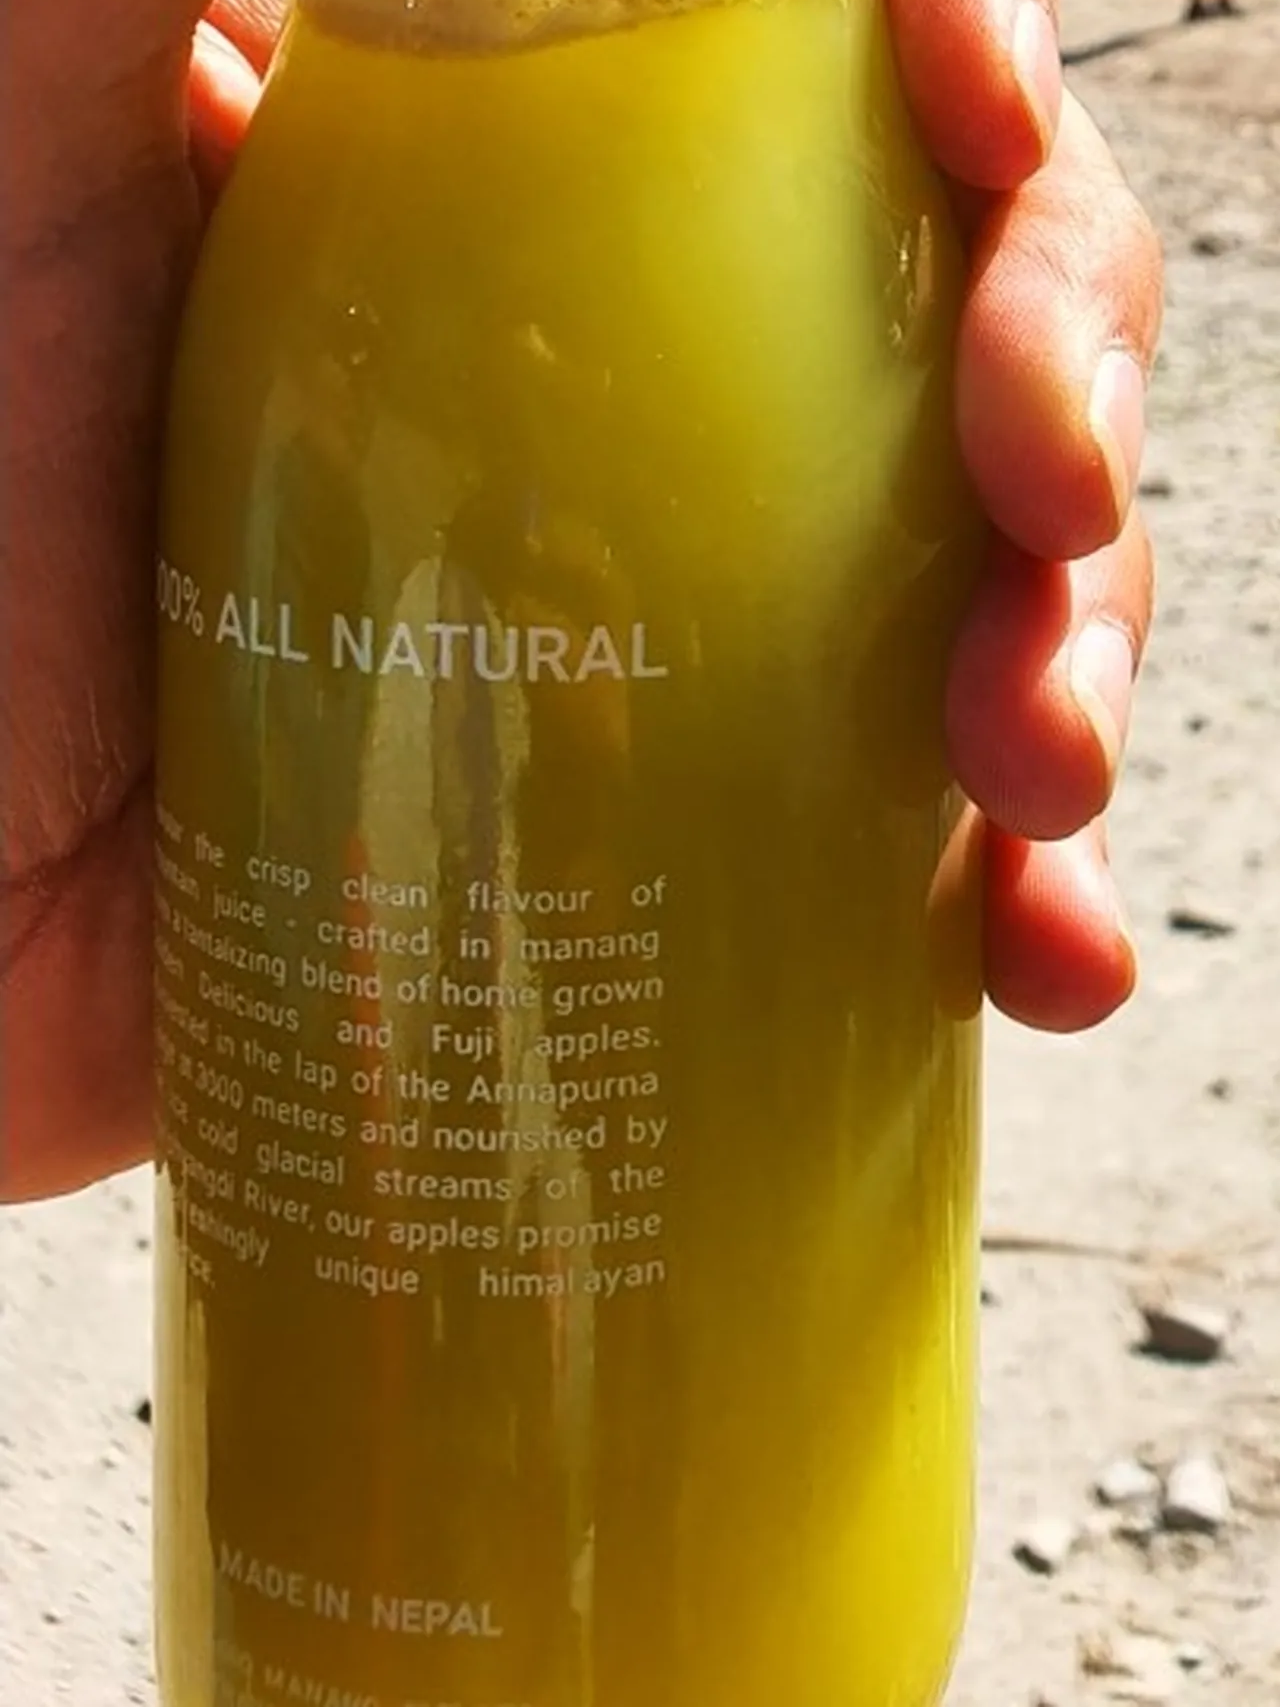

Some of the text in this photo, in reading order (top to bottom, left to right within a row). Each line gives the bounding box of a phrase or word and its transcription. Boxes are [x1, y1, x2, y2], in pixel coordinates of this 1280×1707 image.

[157, 556, 669, 682] 00% ALL NATURAL
[214, 884, 266, 929] juice
[318, 921, 430, 956] crafted
[459, 928, 491, 960] in
[520, 930, 659, 961] manang
[246, 856, 311, 897] crisp
[342, 873, 428, 909] clean
[467, 881, 593, 914] flavour
[631, 874, 667, 908] of
[199, 970, 300, 1032] Delicious
[337, 1018, 393, 1048] and
[432, 1024, 494, 1063] Fuji
[534, 1023, 661, 1063] apples.
[302, 956, 381, 1000] blend
[397, 972, 431, 1003] of
[441, 975, 540, 1007] home
[552, 977, 664, 1016] grown
[244, 1038, 281, 1074] the
[295, 1049, 337, 1094] lap
[351, 1065, 384, 1097] of
[398, 1069, 451, 1102] the
[466, 1071, 659, 1111] Annapurna
[198, 1118, 238, 1156] cold
[256, 1140, 345, 1186] glacial
[374, 1169, 512, 1201] streams
[545, 1167, 588, 1200] of
[608, 1163, 664, 1193] the
[252, 1094, 347, 1137] meters
[360, 1118, 418, 1148] and
[433, 1115, 606, 1152] nourished
[627, 1114, 667, 1149] by
[244, 1178, 316, 1234] River,
[325, 1210, 375, 1239] our
[386, 1217, 500, 1254] apples
[517, 1212, 662, 1256] promise
[314, 1255, 420, 1297] unique
[219, 1540, 504, 1638] MADE IN NEPAL
